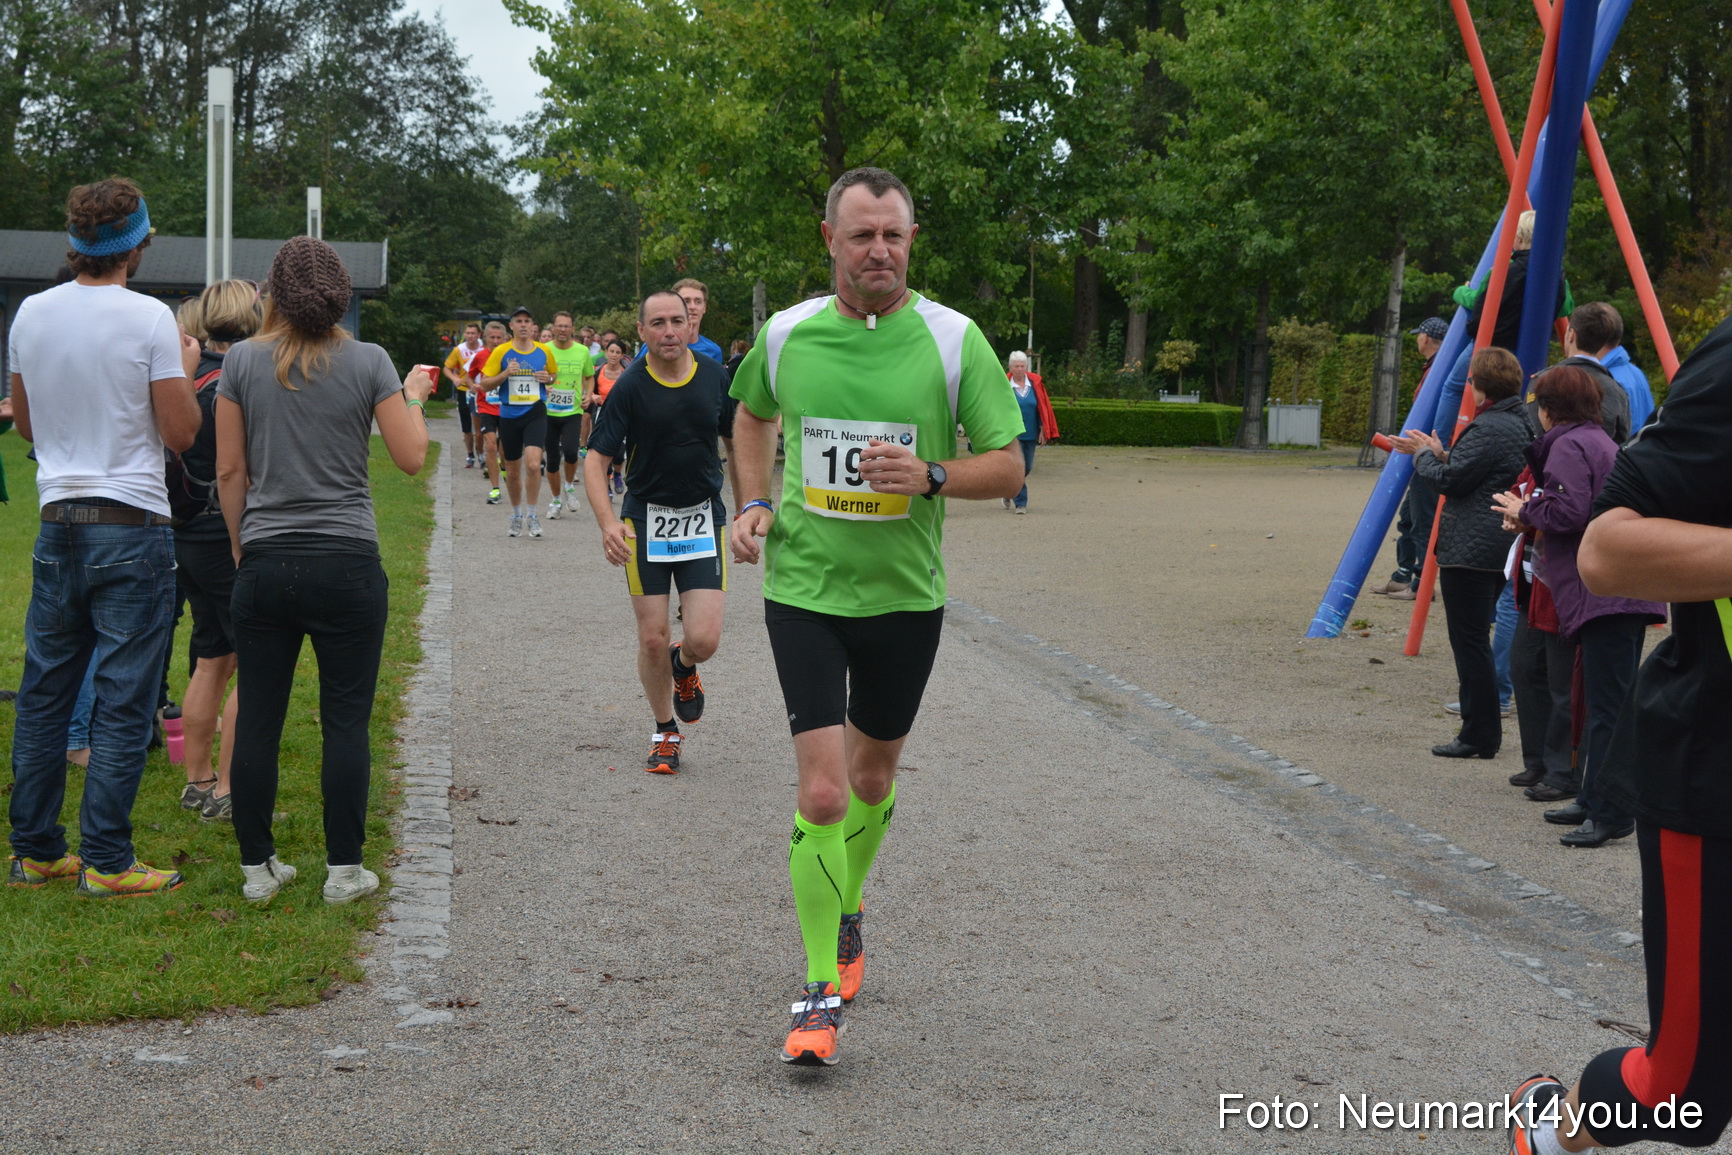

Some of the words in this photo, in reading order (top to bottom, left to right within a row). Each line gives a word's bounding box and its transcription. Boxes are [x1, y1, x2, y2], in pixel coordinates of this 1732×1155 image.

[518, 384, 530, 394] 44
[550, 393, 573, 404] 2245
[804, 427, 838, 440] PARTL
[841, 431, 895, 443] Neumarkt
[827, 495, 880, 513] Werner
[649, 506, 670, 514] PARTL
[672, 506, 701, 514] Neumarkt
[655, 513, 707, 538] 2272
[667, 544, 695, 554] Holger
